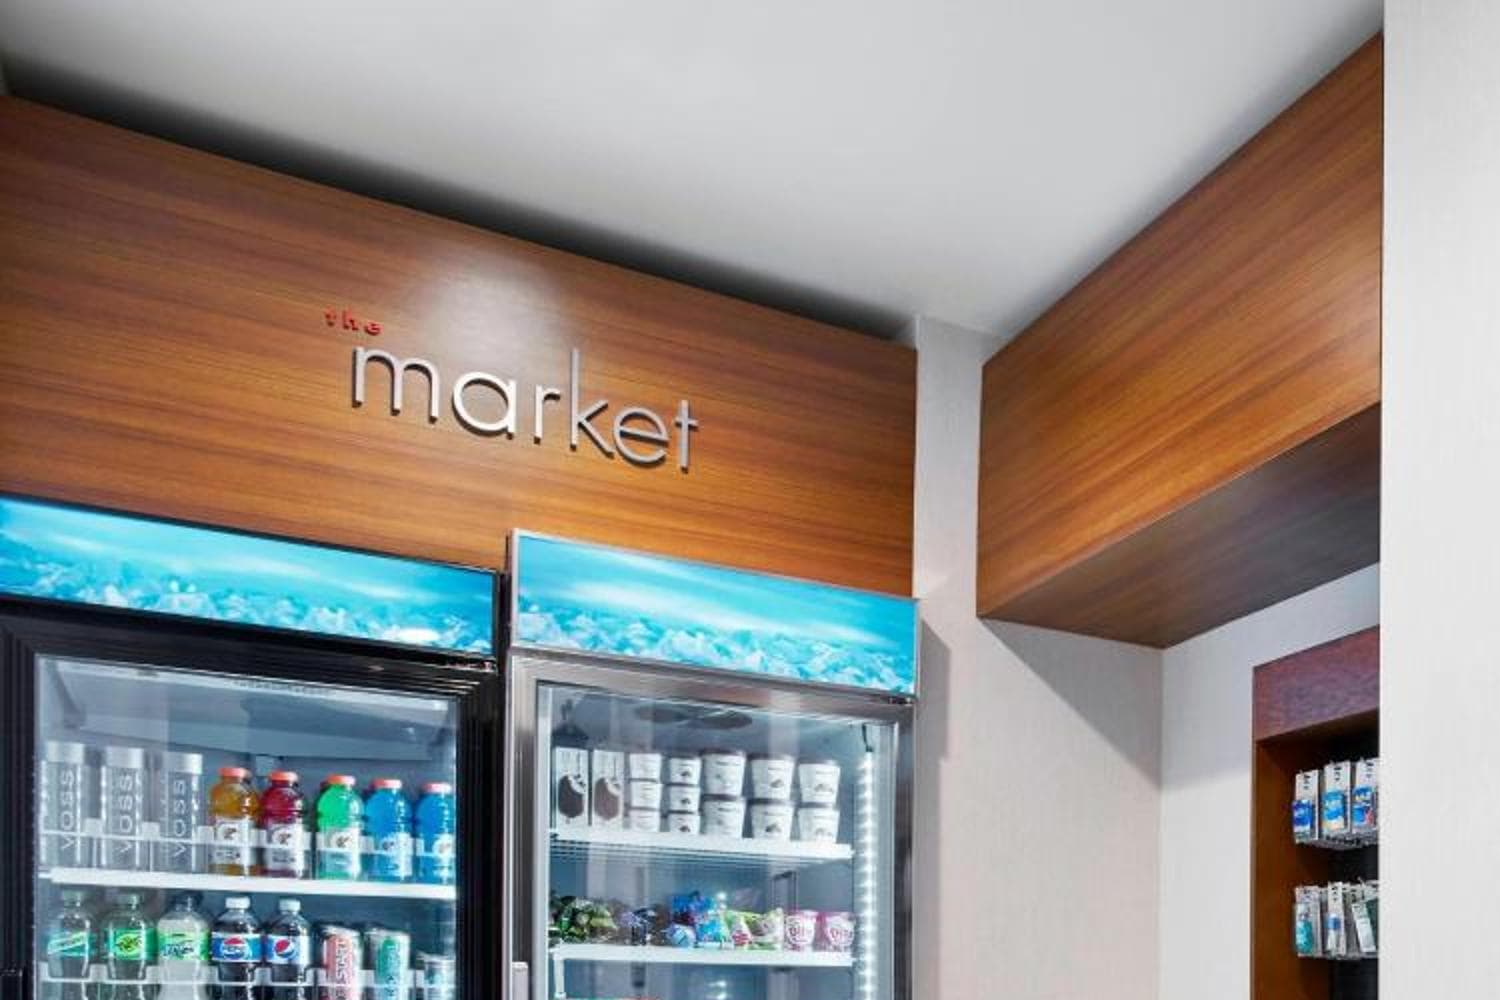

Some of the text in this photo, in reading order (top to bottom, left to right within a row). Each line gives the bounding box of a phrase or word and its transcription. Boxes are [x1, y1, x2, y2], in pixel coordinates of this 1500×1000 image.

[352, 346, 699, 473] market
[60, 769, 76, 849] VOSS
[118, 774, 134, 854] VOSS
[173, 779, 188, 858] VOSS
